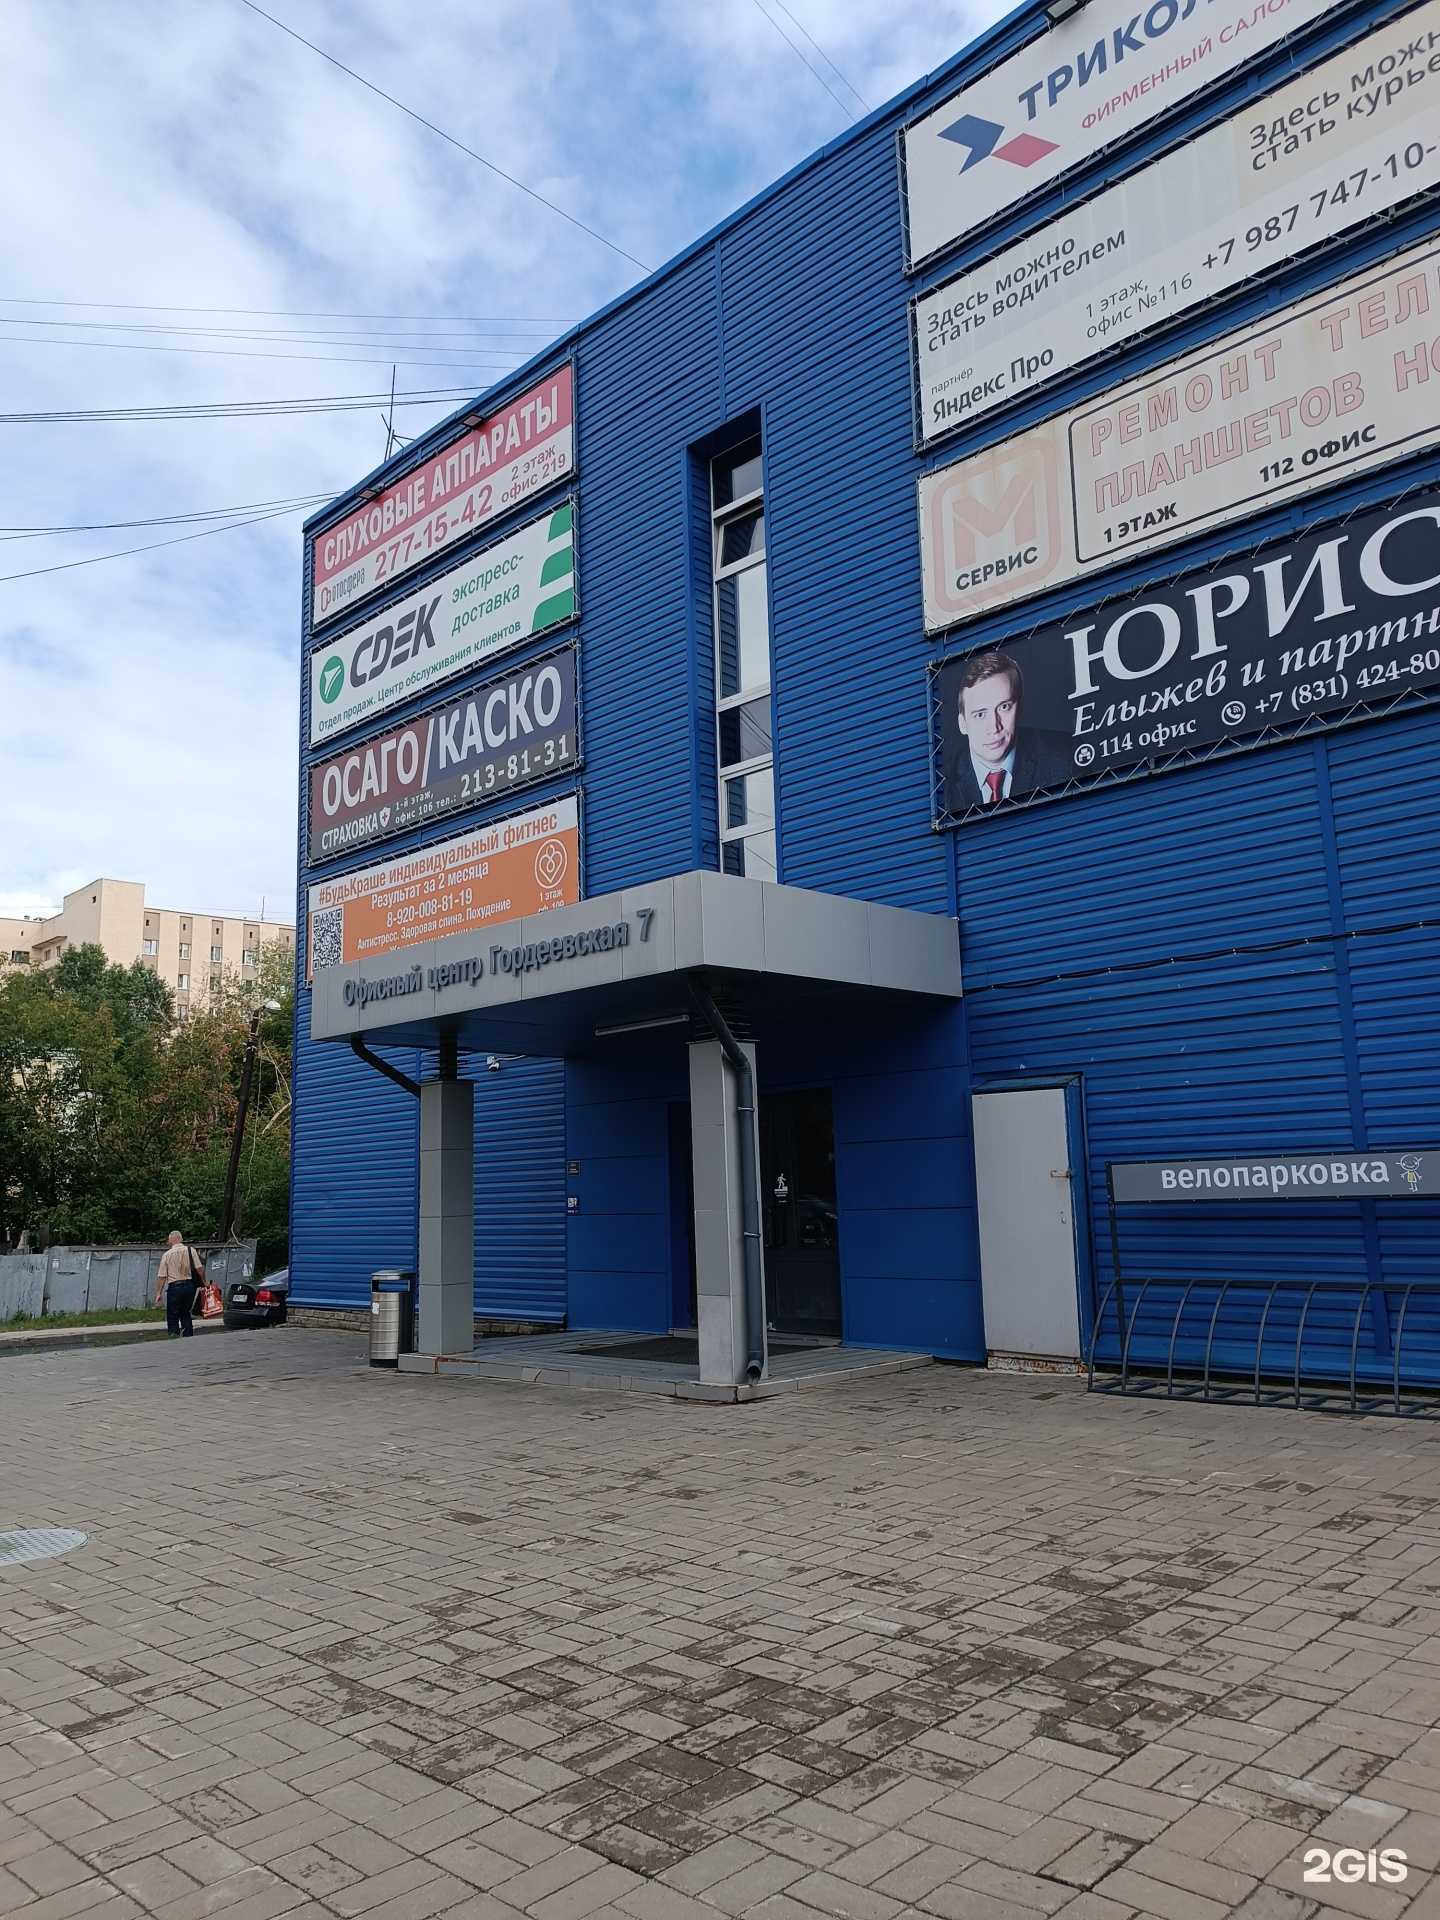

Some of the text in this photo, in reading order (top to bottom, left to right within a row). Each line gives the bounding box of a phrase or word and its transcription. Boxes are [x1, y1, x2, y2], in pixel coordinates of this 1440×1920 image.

[1018, 0, 1216, 121] ТРИКО
[1082, 0, 1290, 128] ФИРМЕННЫЙ САЛО
[1250, 91, 1340, 149] Здесь
[1252, 119, 1336, 171] стать
[1202, 238, 1235, 269] +7
[1245, 204, 1299, 251] 987
[927, 238, 1075, 333] Здесь можно
[928, 230, 1125, 352] стать водителем
[1086, 279, 1148, 318] 1 этаж,
[1087, 272, 1192, 338] офис №116
[932, 348, 1054, 423] Яндекс Про
[1091, 266, 1440, 457] РЕМОНТ ТЕЛ
[511, 444, 556, 481] 2 этаж
[1094, 371, 1364, 513] ПЛАНШЕТОВ
[1259, 424, 1376, 482] 112 ОФИС
[324, 385, 558, 570] СЛУХОВЫЕ АППАРАТЫ
[501, 453, 566, 503] офис 219
[375, 484, 493, 582] 277-15-42
[1103, 502, 1178, 542] 1 ЭТАЖ
[452, 553, 524, 604] экспресс-
[956, 546, 1038, 591] СЕРВИС
[451, 583, 520, 636] доставка
[1063, 506, 1440, 700] ЮРИС
[350, 594, 442, 688] CDEK
[318, 620, 521, 732] Отдел продаж. Центр обслуживания клиентов
[1072, 659, 1227, 737] Елыжев
[1240, 661, 1266, 688] и
[1255, 650, 1440, 714] +7 (831) 424-80
[1099, 719, 1197, 757] 114 офис
[395, 809, 416, 824] офис
[418, 801, 433, 816] 106
[460, 734, 569, 798] 213-81-31
[321, 813, 378, 850] СТРАХОВКА
[389, 830, 499, 884] индивидуальный
[503, 812, 557, 849] фитнес
[371, 863, 489, 910] Результат за 2 месяца
[387, 888, 473, 928] 8-920-008-81-19
[401, 922, 437, 941] Здоровая
[466, 898, 511, 922] Похудение
[343, 964, 422, 1010] Офисный
[427, 957, 483, 991] центр
[489, 921, 629, 976] Гордеевская
[636, 907, 654, 942] 7
[1160, 1161, 1390, 1192] велопарковка
